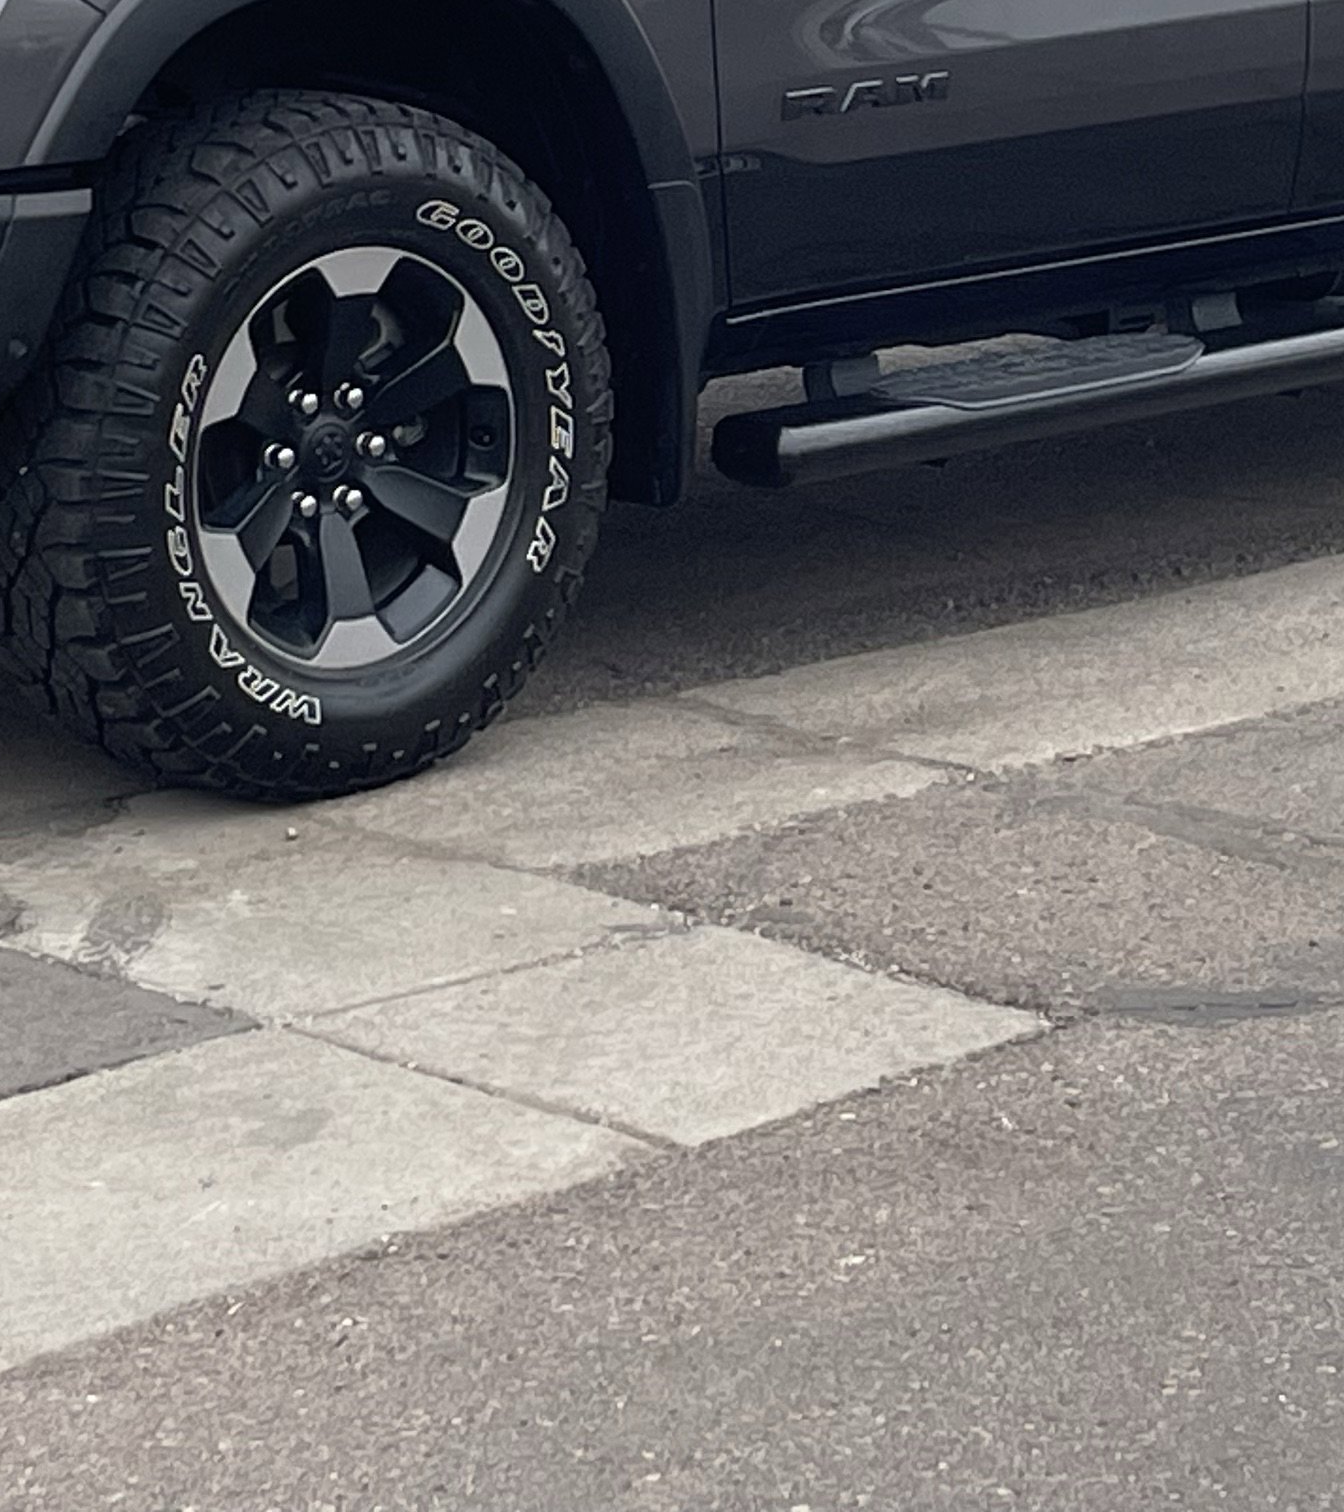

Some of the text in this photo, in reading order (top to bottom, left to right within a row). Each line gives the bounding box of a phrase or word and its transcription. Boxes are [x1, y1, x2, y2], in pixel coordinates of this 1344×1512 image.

[781, 71, 949, 121] RAM
[165, 354, 323, 725] WRANGLER
[415, 199, 575, 574] GOODYEAR
